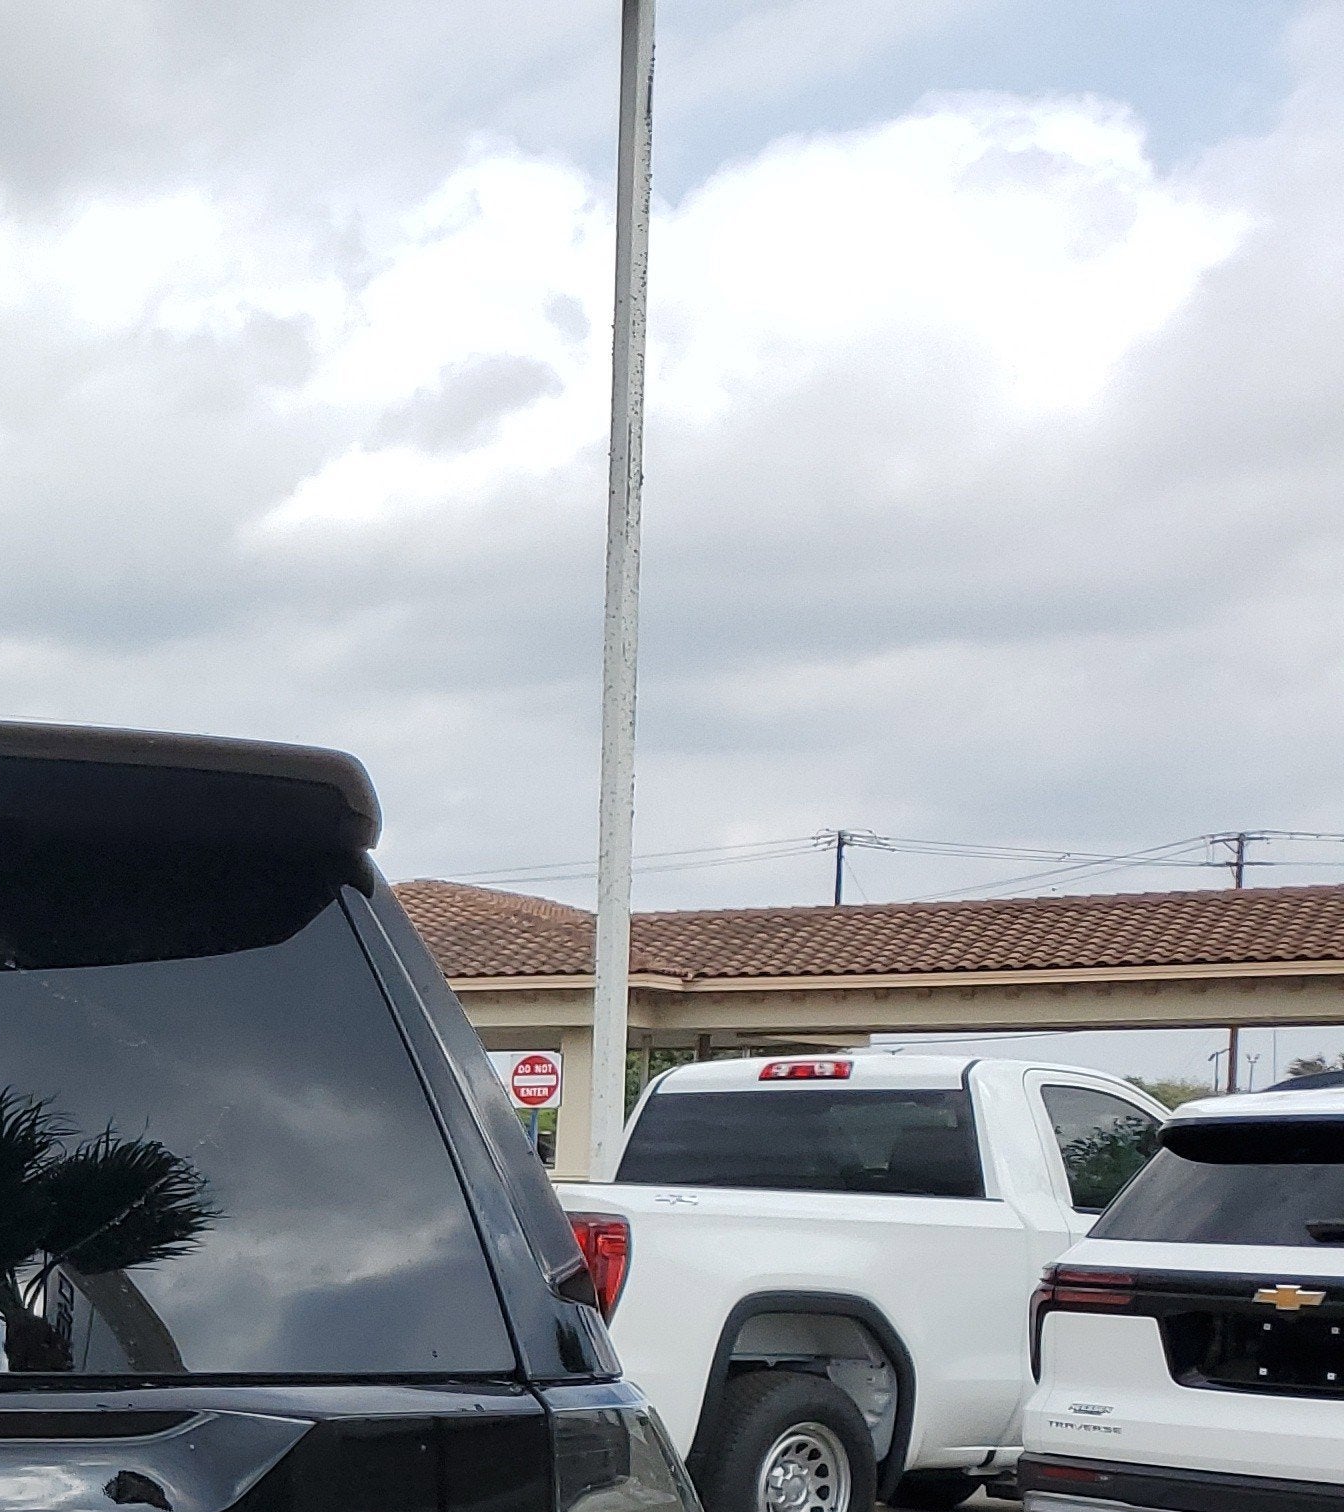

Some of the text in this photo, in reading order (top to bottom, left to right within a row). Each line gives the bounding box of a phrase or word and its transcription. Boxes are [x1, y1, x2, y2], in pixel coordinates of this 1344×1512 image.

[517, 1063, 553, 1074] DO NOT
[519, 1087, 549, 1097] ENTER
[1048, 1420, 1122, 1434] TRAVERSE
